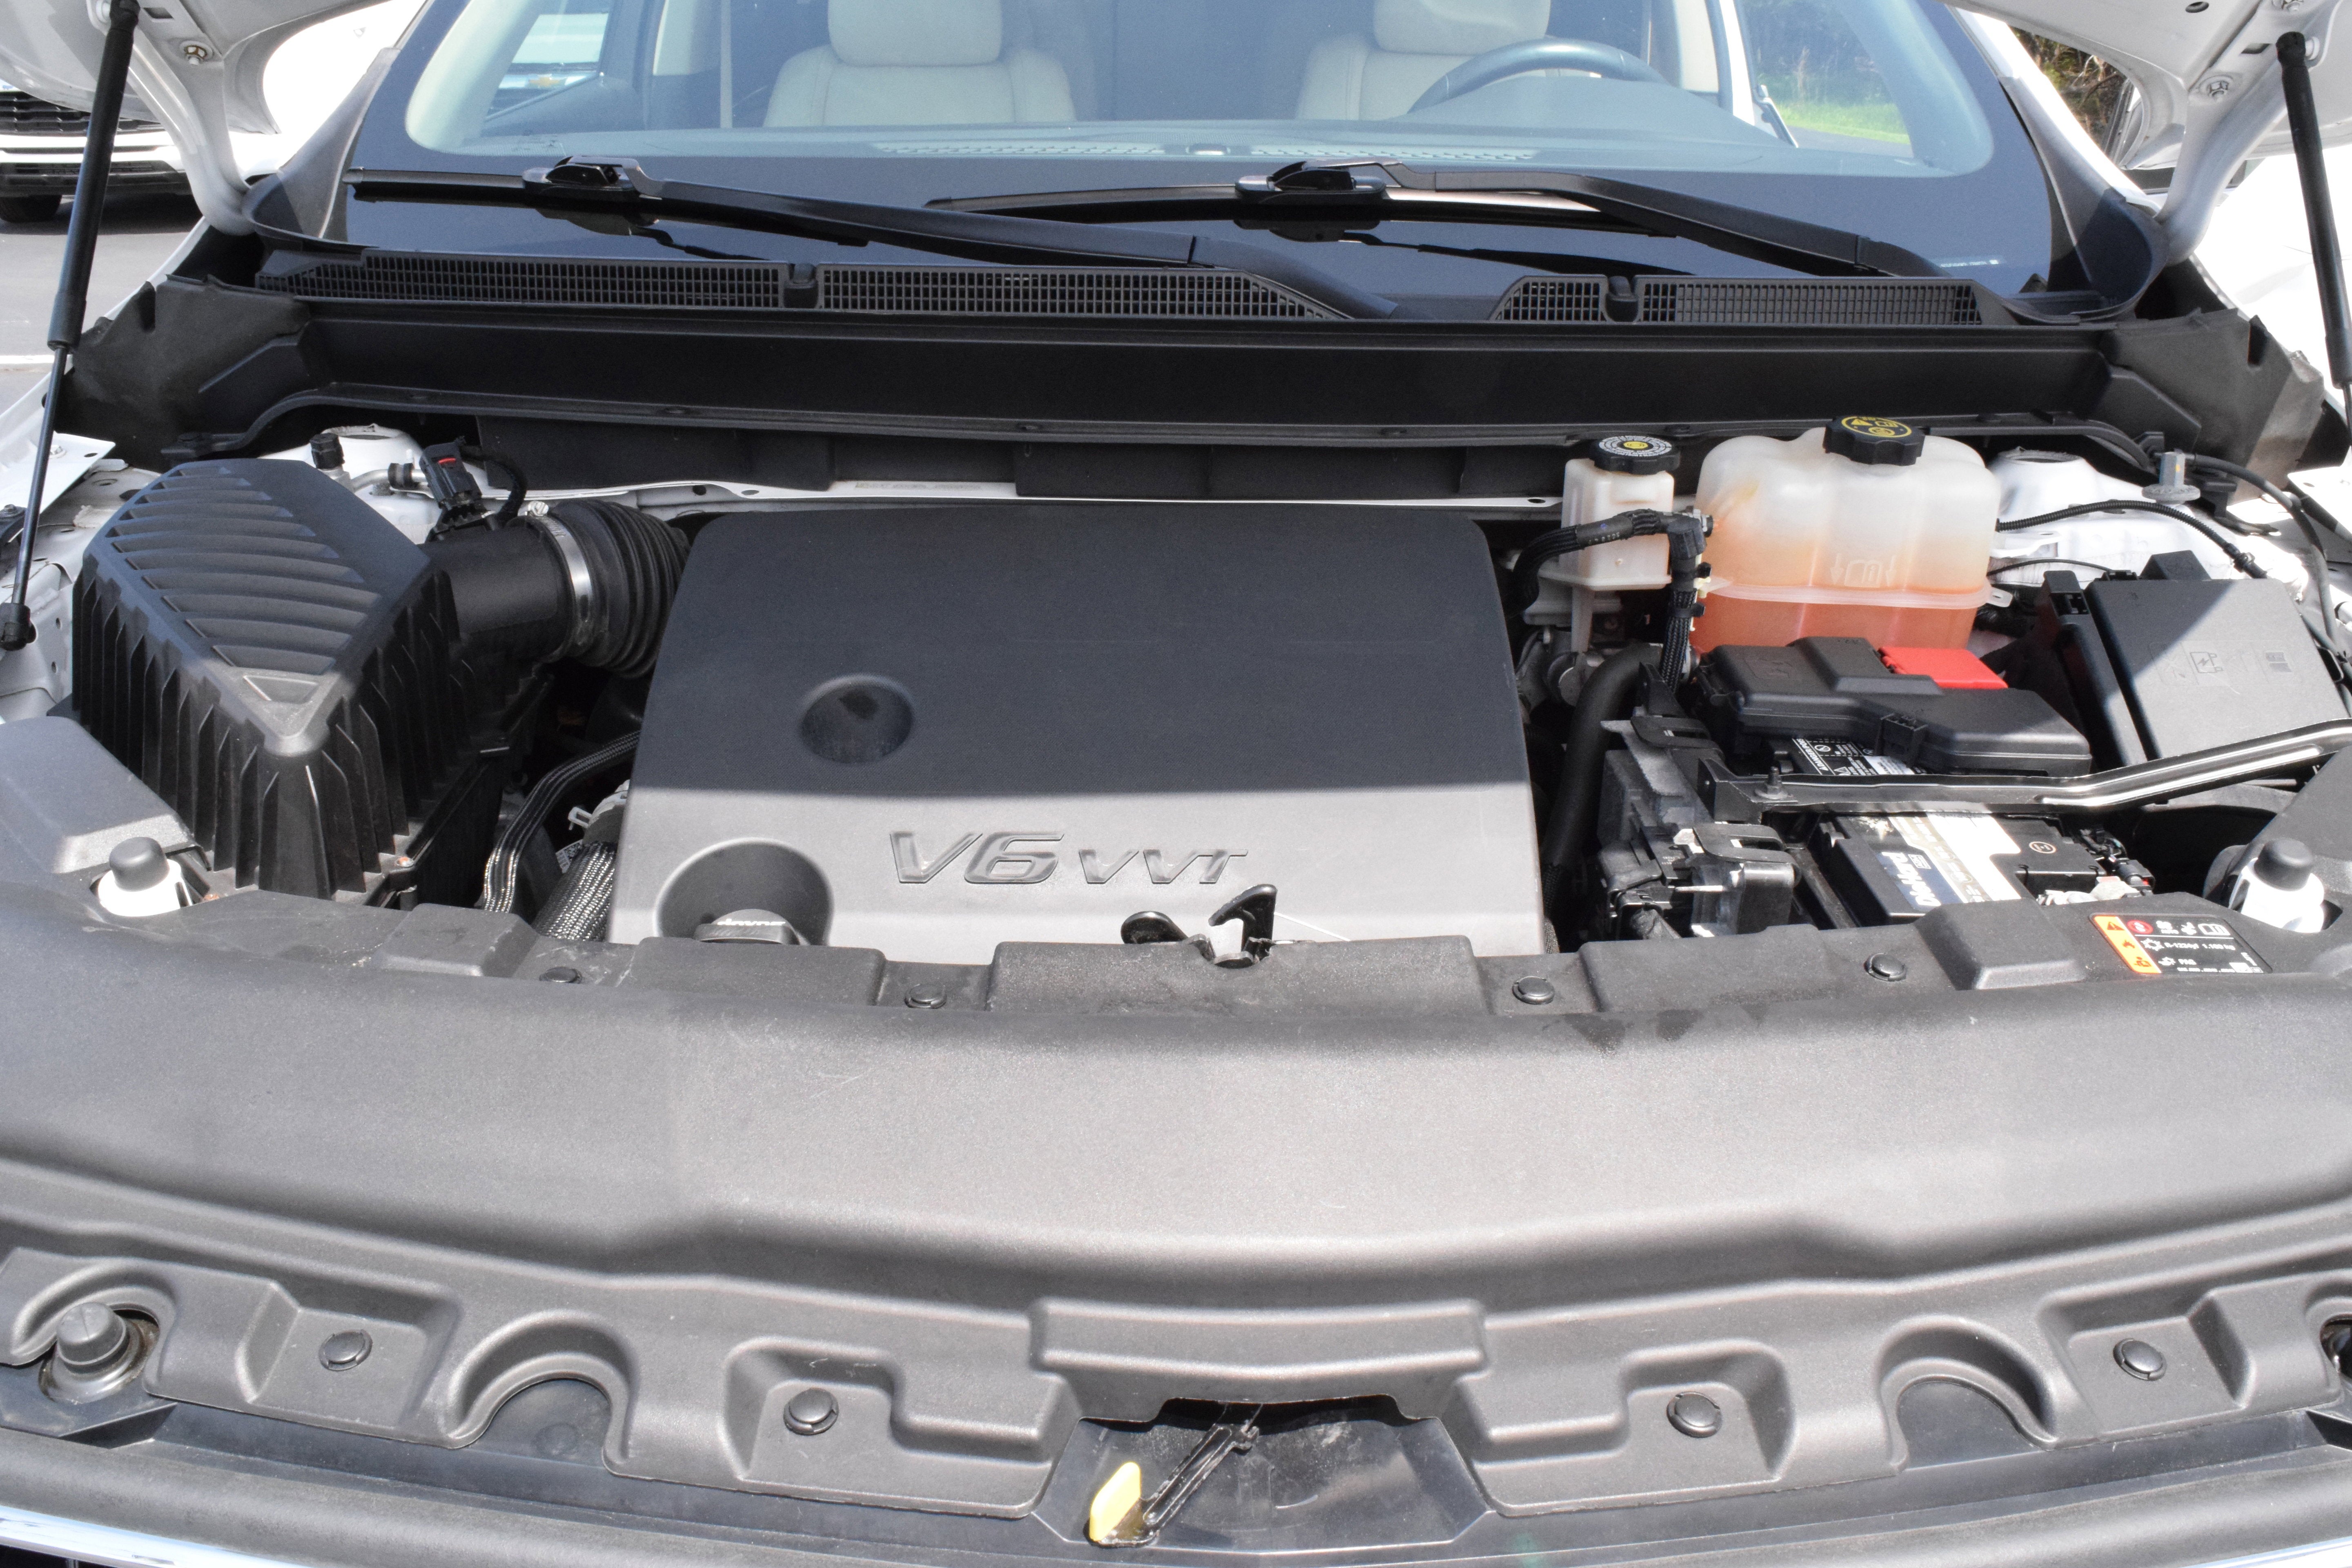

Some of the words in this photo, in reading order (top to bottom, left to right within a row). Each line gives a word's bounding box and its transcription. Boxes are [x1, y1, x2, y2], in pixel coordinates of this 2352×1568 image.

[890, 831, 1065, 884] V6
[1078, 849, 1249, 884] VVT
[1881, 852, 1941, 906] DieHard
